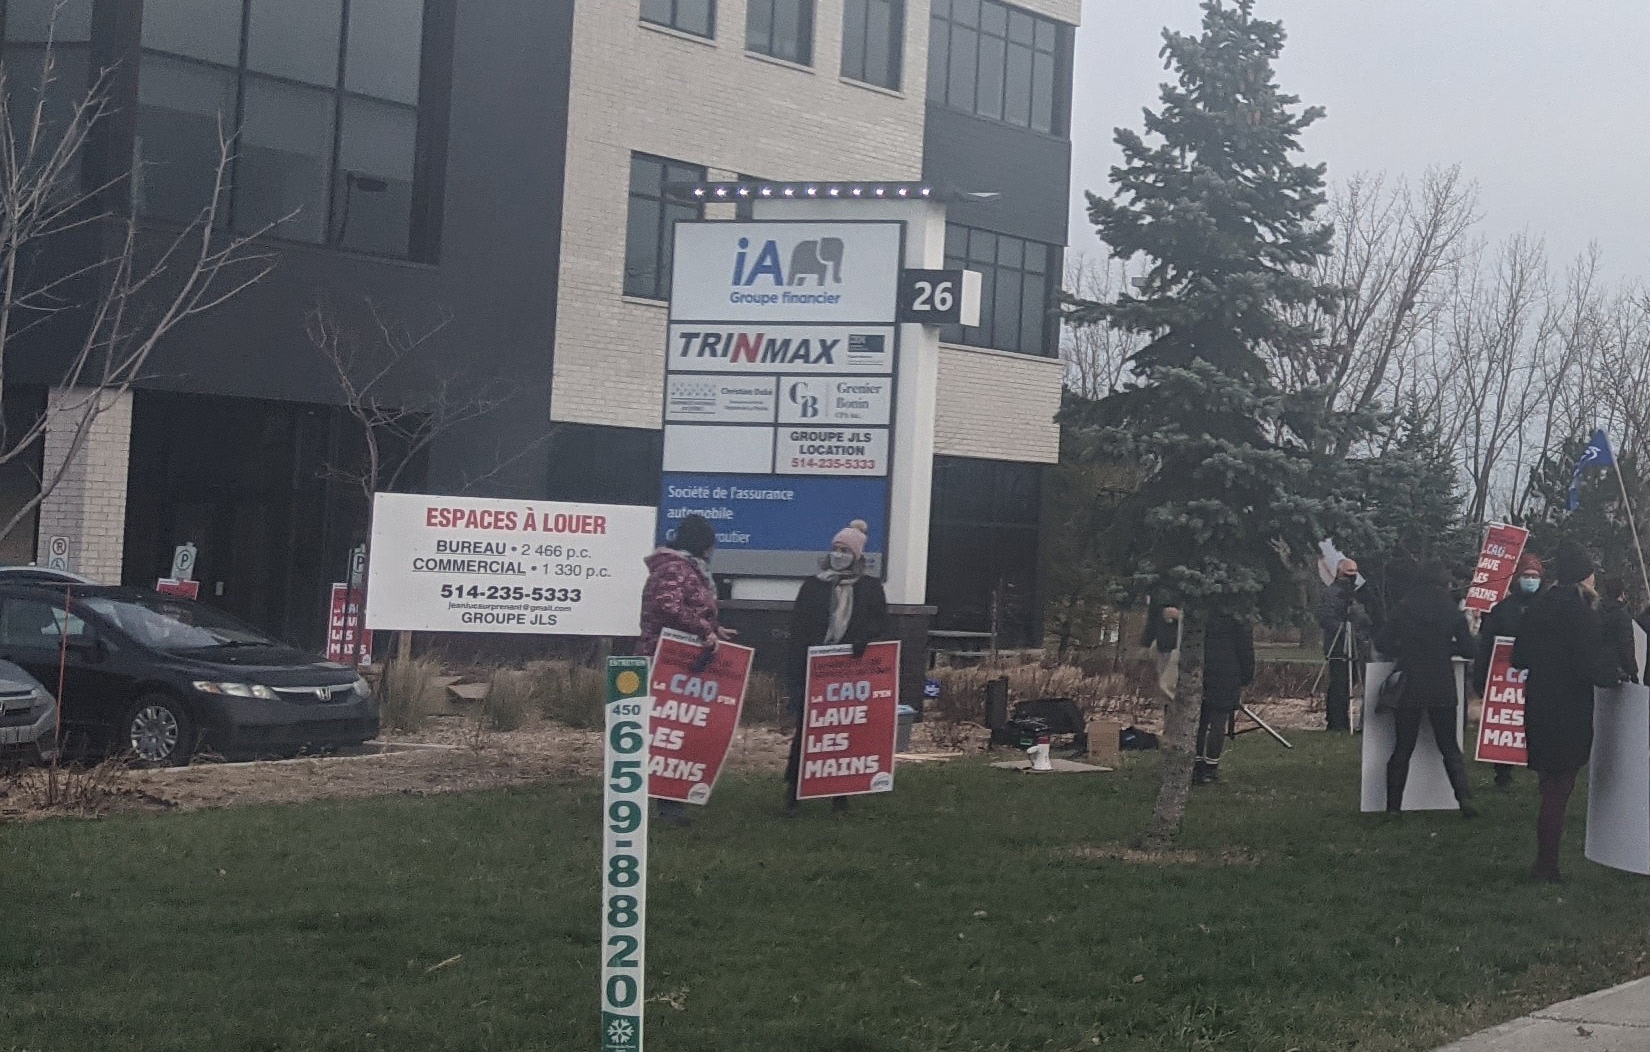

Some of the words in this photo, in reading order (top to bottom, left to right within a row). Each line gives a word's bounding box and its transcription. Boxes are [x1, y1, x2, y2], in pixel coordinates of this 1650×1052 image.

[731, 237, 783, 286] iA
[730, 291, 778, 305] Groupe
[782, 291, 840, 304] financier
[912, 281, 953, 311] 26
[679, 332, 841, 364] TRINMAX
[837, 382, 882, 394] Grenier
[790, 431, 844, 442] GROUPE
[848, 432, 872, 442] JLS
[799, 445, 865, 456] LOCATION
[791, 458, 875, 469] 514-235-5333
[668, 485, 710, 498] Société
[713, 487, 728, 499] de
[730, 487, 795, 501] l'assurance
[426, 507, 517, 531] ESPACES
[523, 507, 537, 532] À
[543, 513, 607, 535] LOUER
[436, 539, 506, 555] BUREAU
[521, 543, 531, 556] 2
[535, 545, 563, 557] 466
[566, 548, 592, 560] p.c.
[413, 557, 526, 575] COMMERCIAL
[542, 563, 549, 575] 1
[554, 564, 582, 577] 330
[585, 566, 611, 579] p.c.
[440, 584, 582, 602] 514-235-5333
[461, 612, 526, 625] GROUPE
[530, 613, 558, 626] JLS
[1506, 667, 1529, 683] CA
[669, 674, 718, 703] CAQ
[826, 680, 872, 702] CAQ
[612, 705, 641, 716] 450
[649, 695, 710, 727] LAVE
[809, 705, 868, 728] LAVE
[1486, 707, 1525, 726] LES
[807, 732, 850, 754] LES
[1483, 728, 1526, 748] MAI
[648, 754, 706, 782] AINS
[804, 754, 880, 780] MAINS
